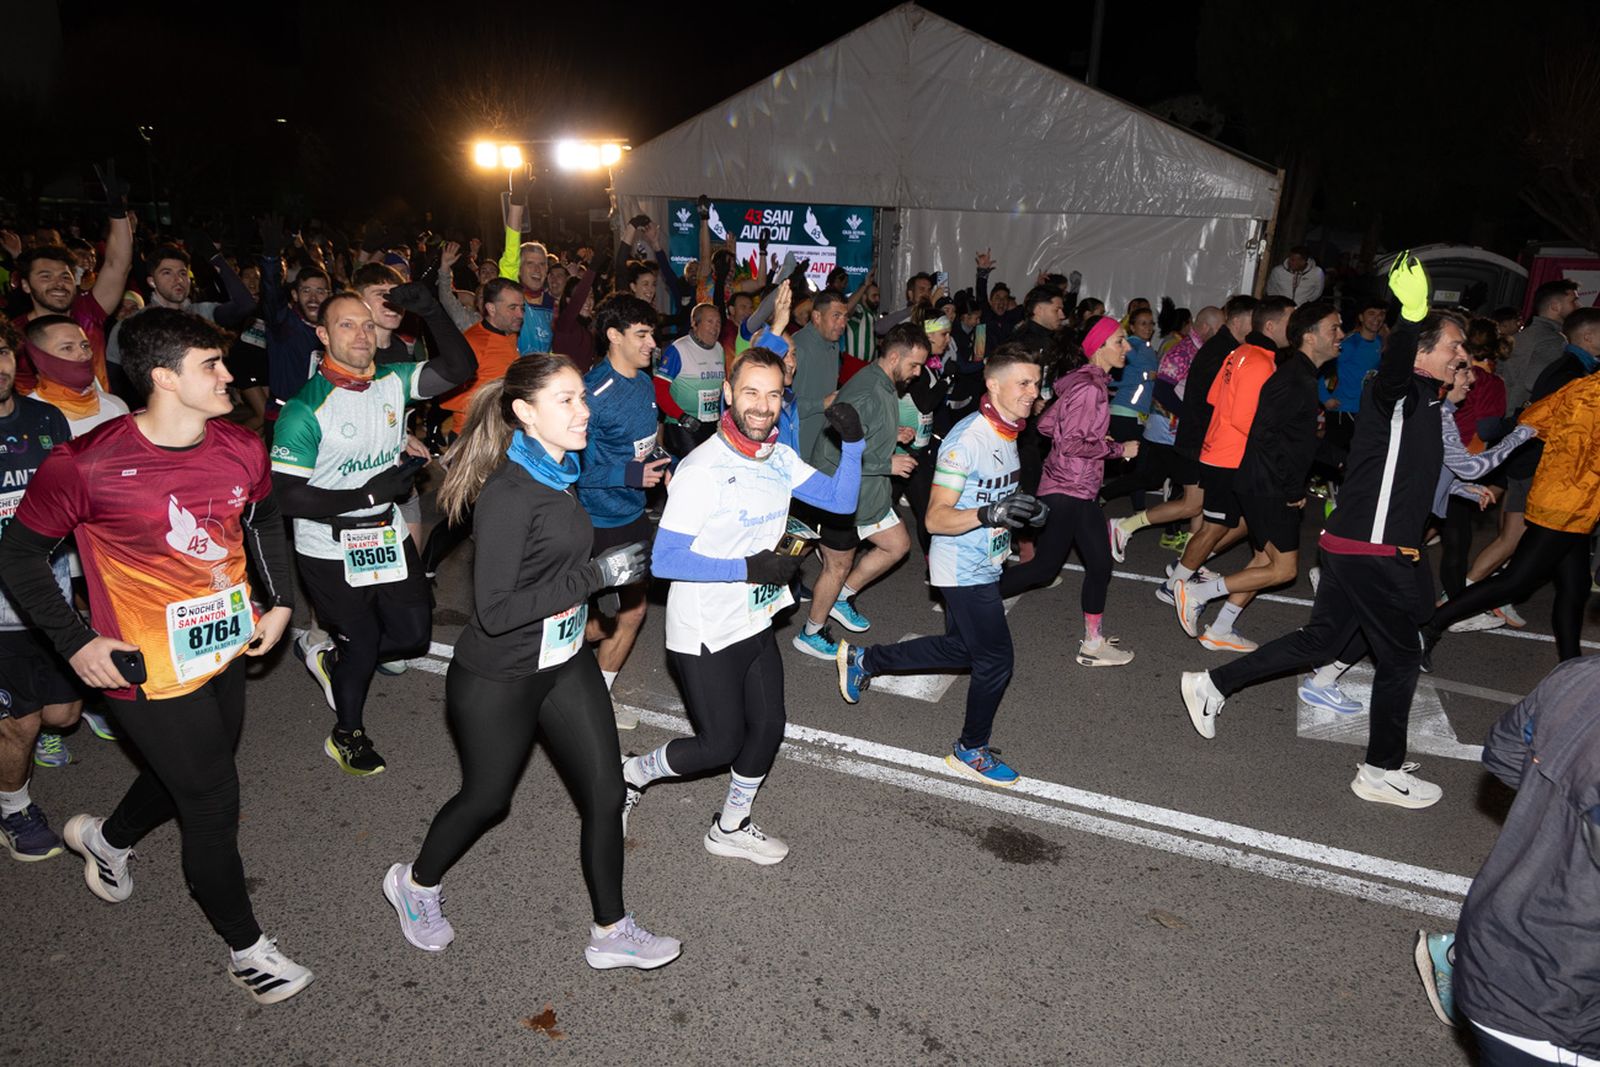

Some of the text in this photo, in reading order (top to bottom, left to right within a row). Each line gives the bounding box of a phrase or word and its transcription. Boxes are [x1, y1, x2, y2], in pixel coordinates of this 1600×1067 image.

[187, 536, 208, 554] 43
[349, 546, 397, 567] 13505
[188, 603, 215, 616] NOCHE
[216, 600, 225, 610] DE
[178, 617, 197, 629] SAN
[189, 615, 241, 650] 8764
[195, 639, 237, 657] MARIO ALBERTO
